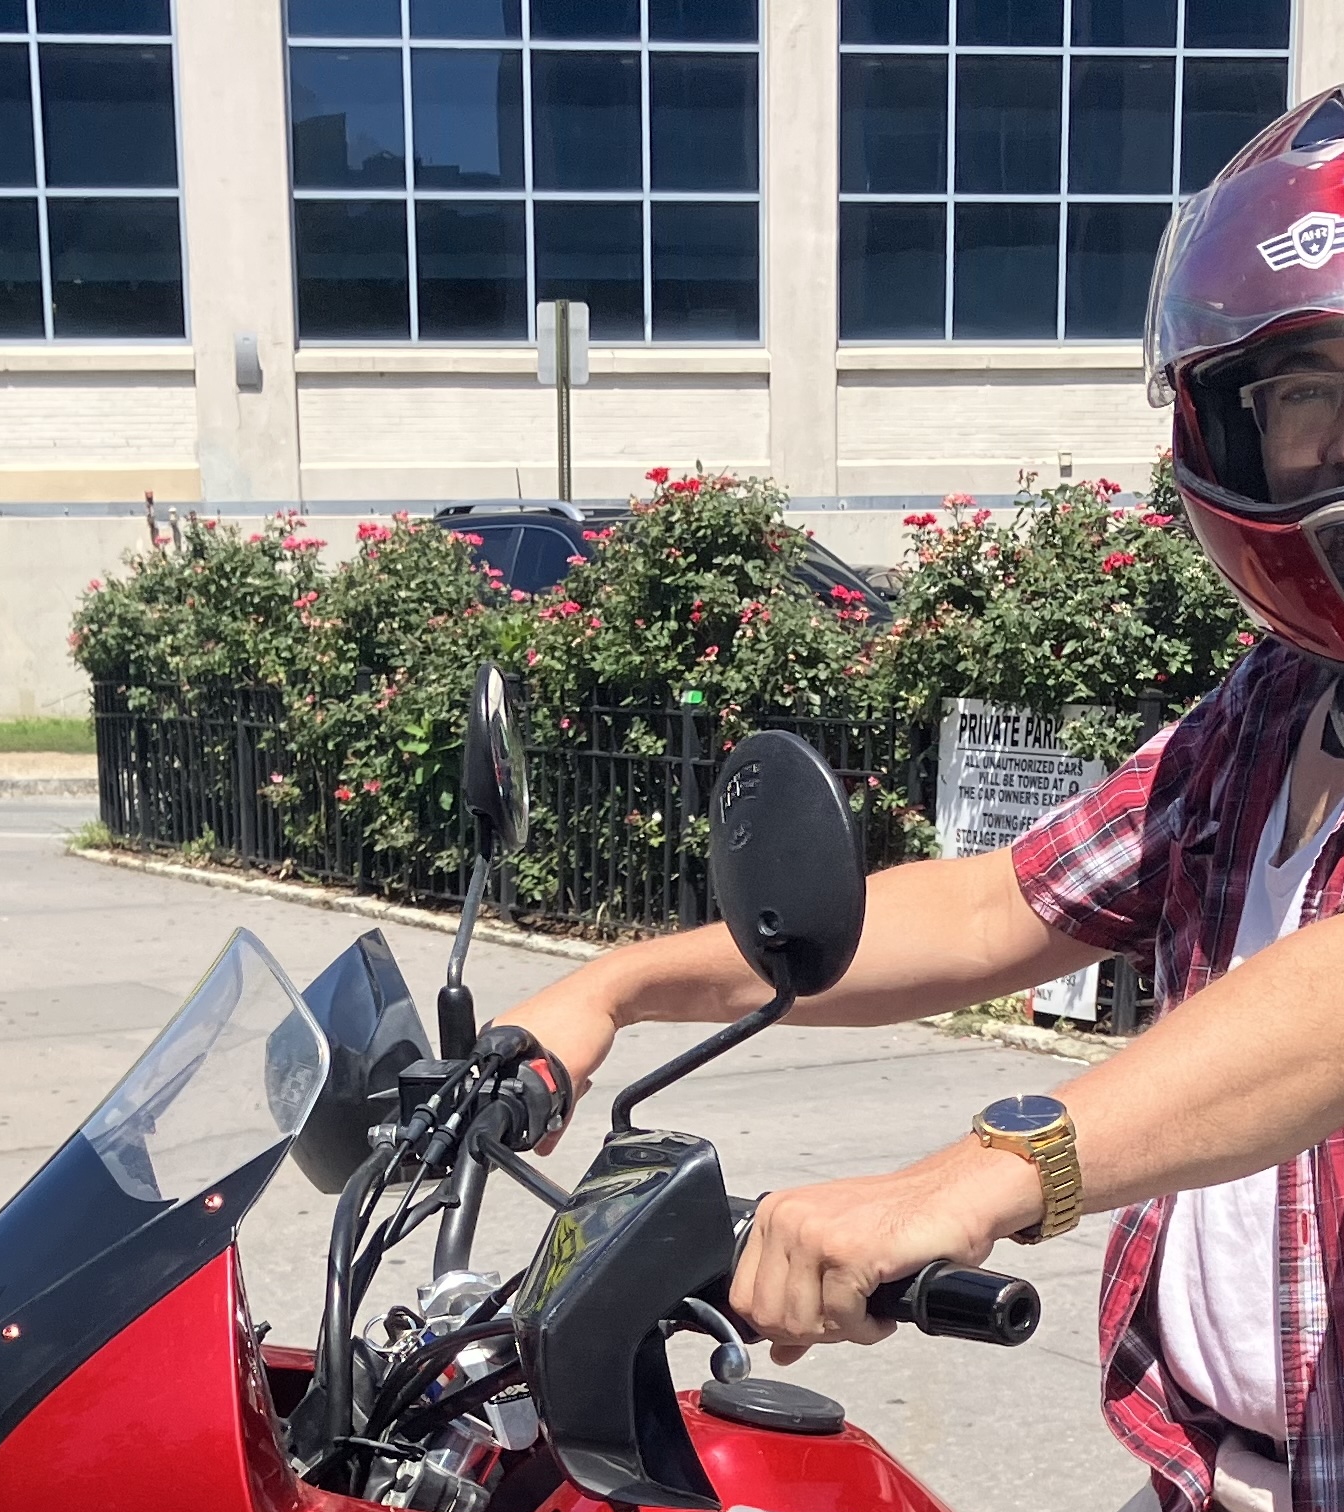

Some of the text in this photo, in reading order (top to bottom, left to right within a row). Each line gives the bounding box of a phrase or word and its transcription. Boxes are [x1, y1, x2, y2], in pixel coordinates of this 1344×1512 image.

[958, 713, 1020, 747] PRIVATE
[965, 755, 1083, 777] ALL UNAUTHORIZED CARS
[979, 772, 1064, 791] WILL BE TOWED AT
[959, 785, 975, 800] THE
[978, 787, 996, 803] CAR
[998, 790, 1040, 806] OWNER'S
[982, 812, 1018, 831] TOWING
[956, 828, 996, 846] STORAGE
